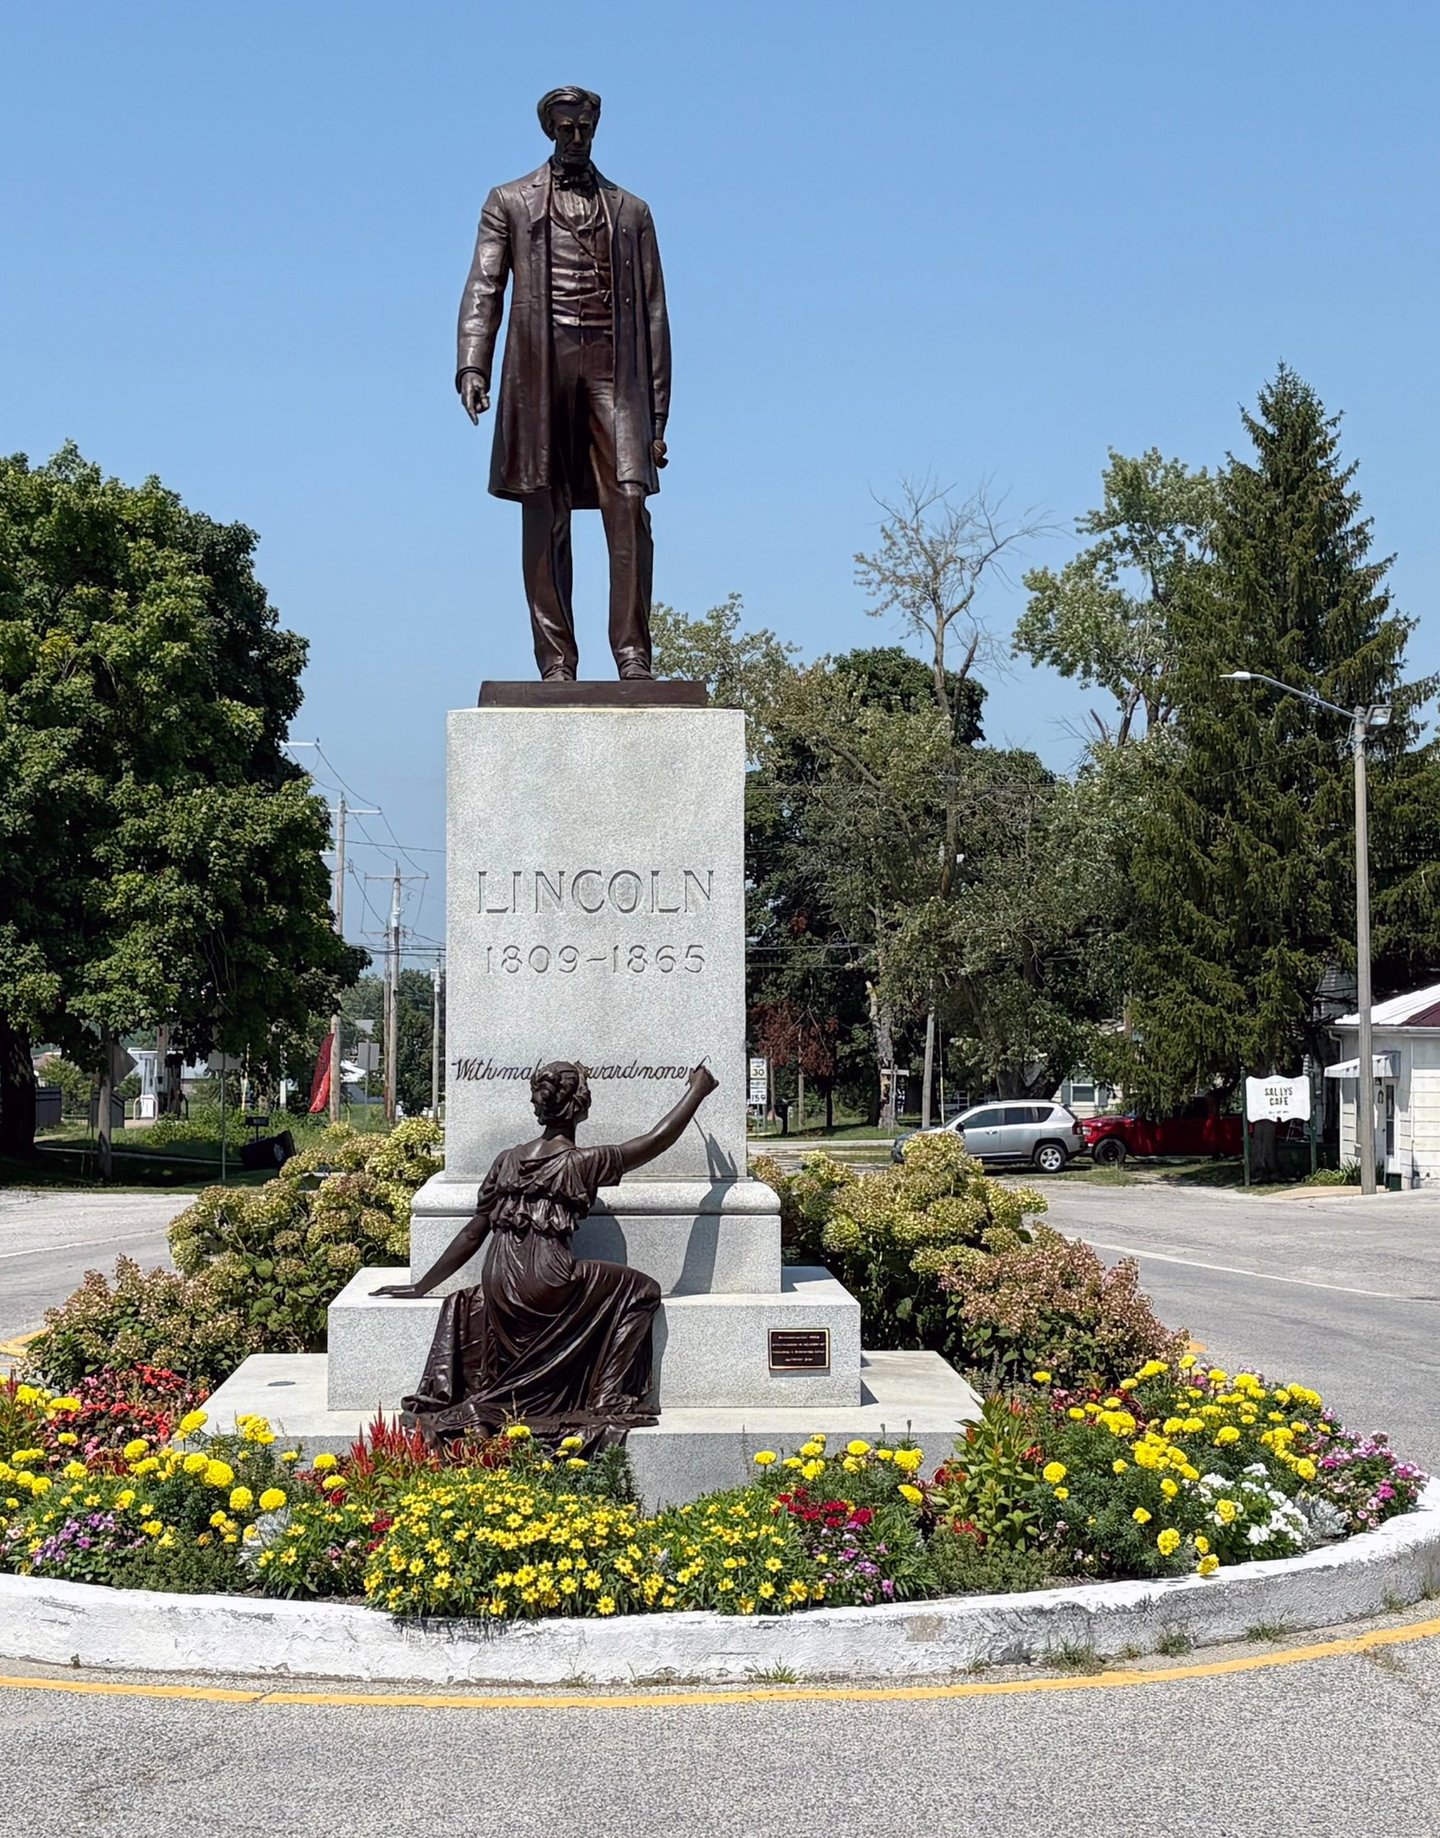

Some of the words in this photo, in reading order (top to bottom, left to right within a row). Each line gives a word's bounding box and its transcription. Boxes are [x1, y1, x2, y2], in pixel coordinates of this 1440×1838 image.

[477, 869, 715, 915] LINCOLN
[451, 1058, 499, 1081] With
[637, 1065, 688, 1081] none
[752, 1068, 765, 1076] 30
